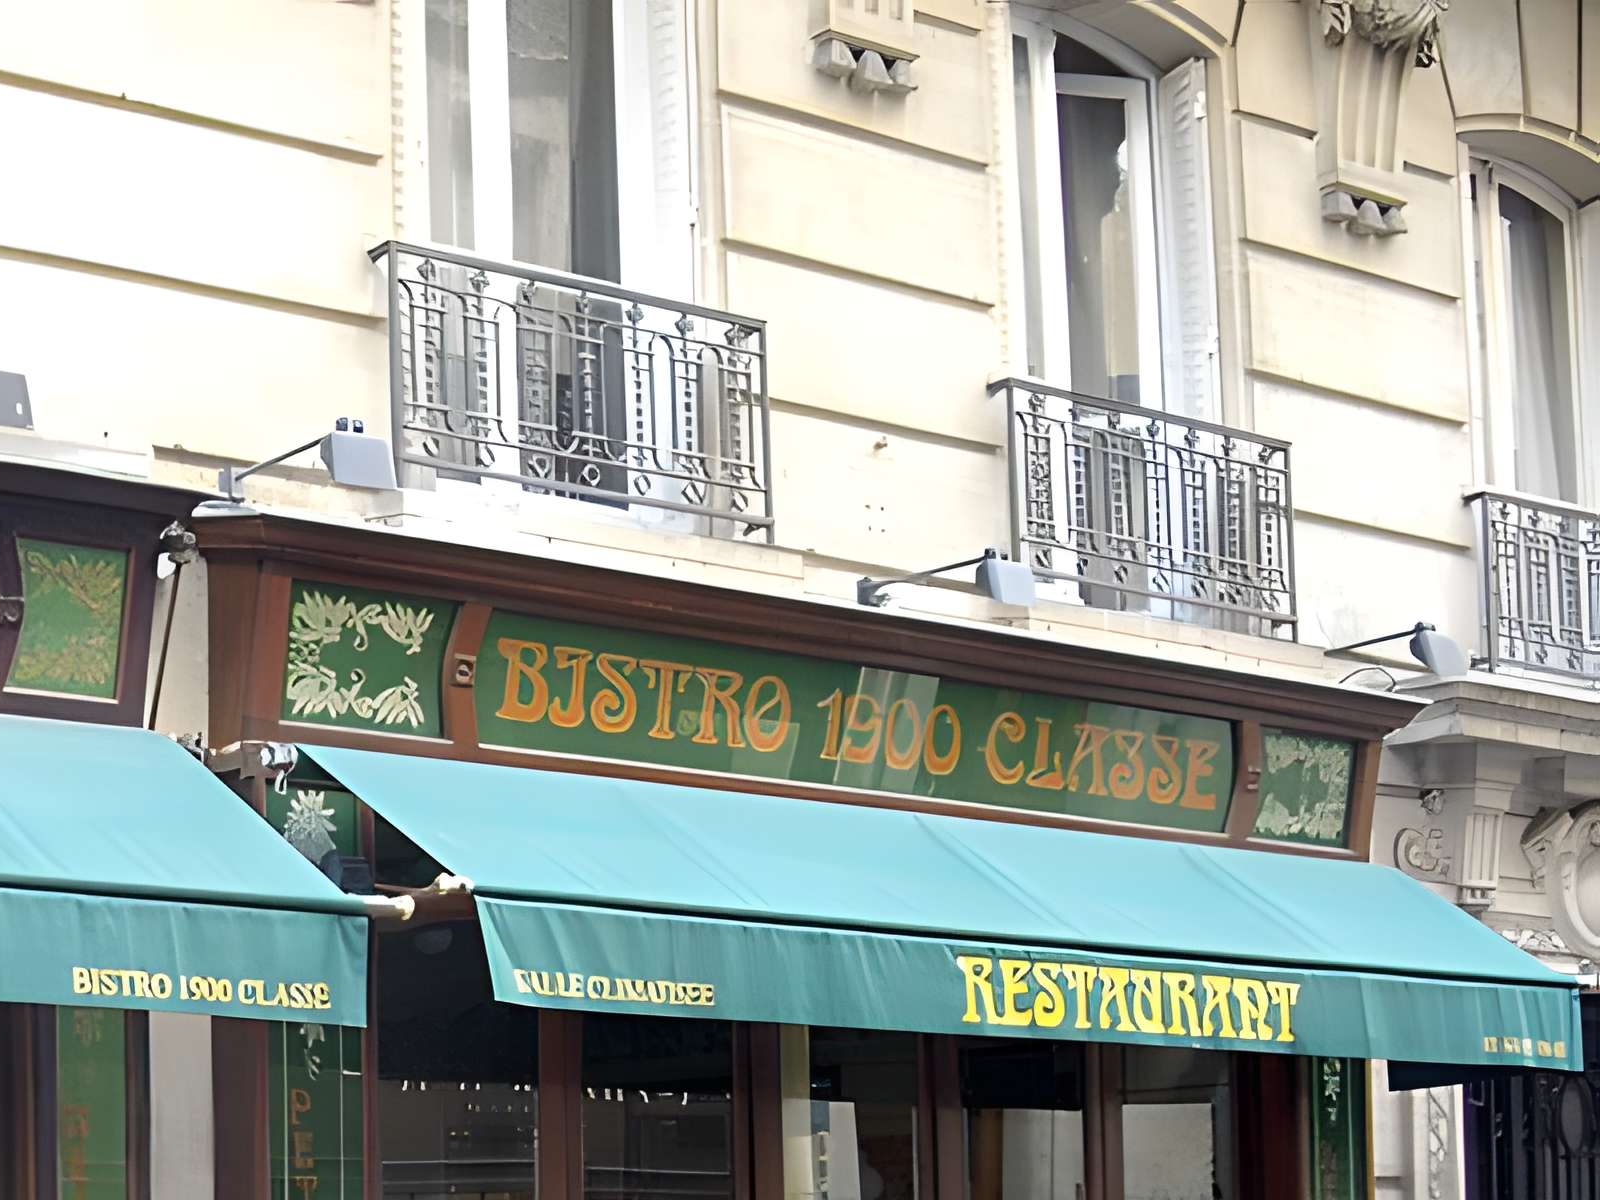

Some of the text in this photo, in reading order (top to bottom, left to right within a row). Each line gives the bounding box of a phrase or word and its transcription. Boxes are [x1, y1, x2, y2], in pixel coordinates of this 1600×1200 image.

[494, 636, 1221, 810] BISTRO 1900 CLASSE
[72, 966, 332, 1010] BISTRO 1900 CLASSE
[956, 955, 1301, 1042] RESTAURANT
